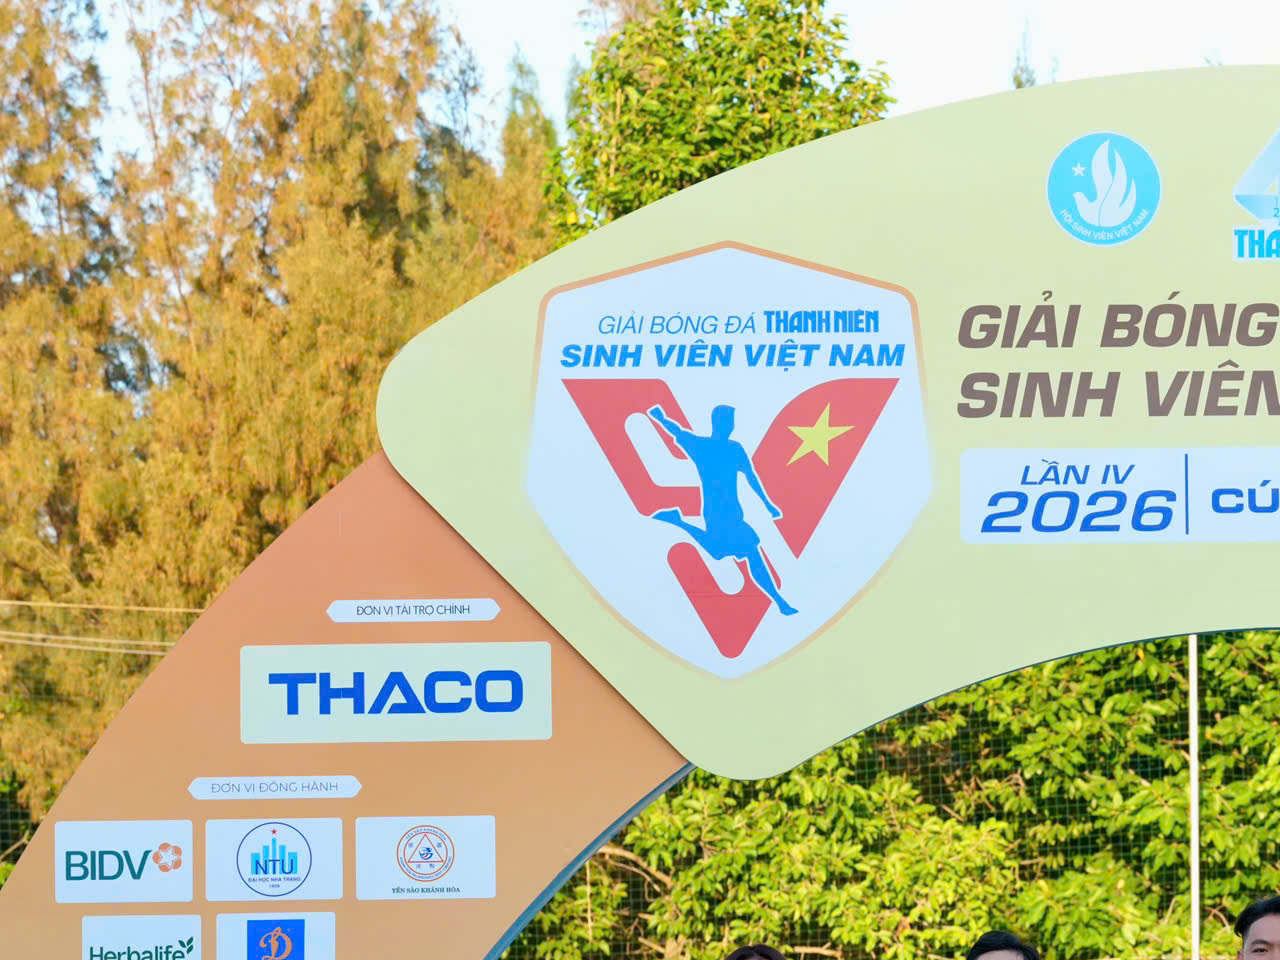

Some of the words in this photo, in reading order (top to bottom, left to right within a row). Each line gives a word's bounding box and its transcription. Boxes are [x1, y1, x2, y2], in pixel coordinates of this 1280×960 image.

[598, 310, 644, 334] GIẢI
[650, 312, 718, 334] BÓNG
[724, 312, 756, 334] ĐÁ
[763, 310, 831, 333] THANH
[834, 308, 879, 333] NIÊN
[957, 290, 1081, 349] GIẢI
[1100, 291, 1280, 349] BÓNG
[560, 343, 642, 368] SINH
[654, 339, 733, 367] VIÊN
[744, 339, 821, 372] VIỆT
[828, 344, 906, 367] NAM
[957, 370, 1121, 419] SINH
[1020, 458, 1089, 485] LẦN
[1101, 463, 1136, 484] IV
[980, 489, 1177, 533] 2026
[356, 605, 381, 616] ĐƠN
[395, 603, 411, 615] TÀI
[413, 604, 435, 616] TRỢ
[436, 602, 470, 615] CHÍNH
[268, 669, 523, 715] THACO
[65, 850, 151, 881] BIDV
[255, 859, 293, 875] NTU
